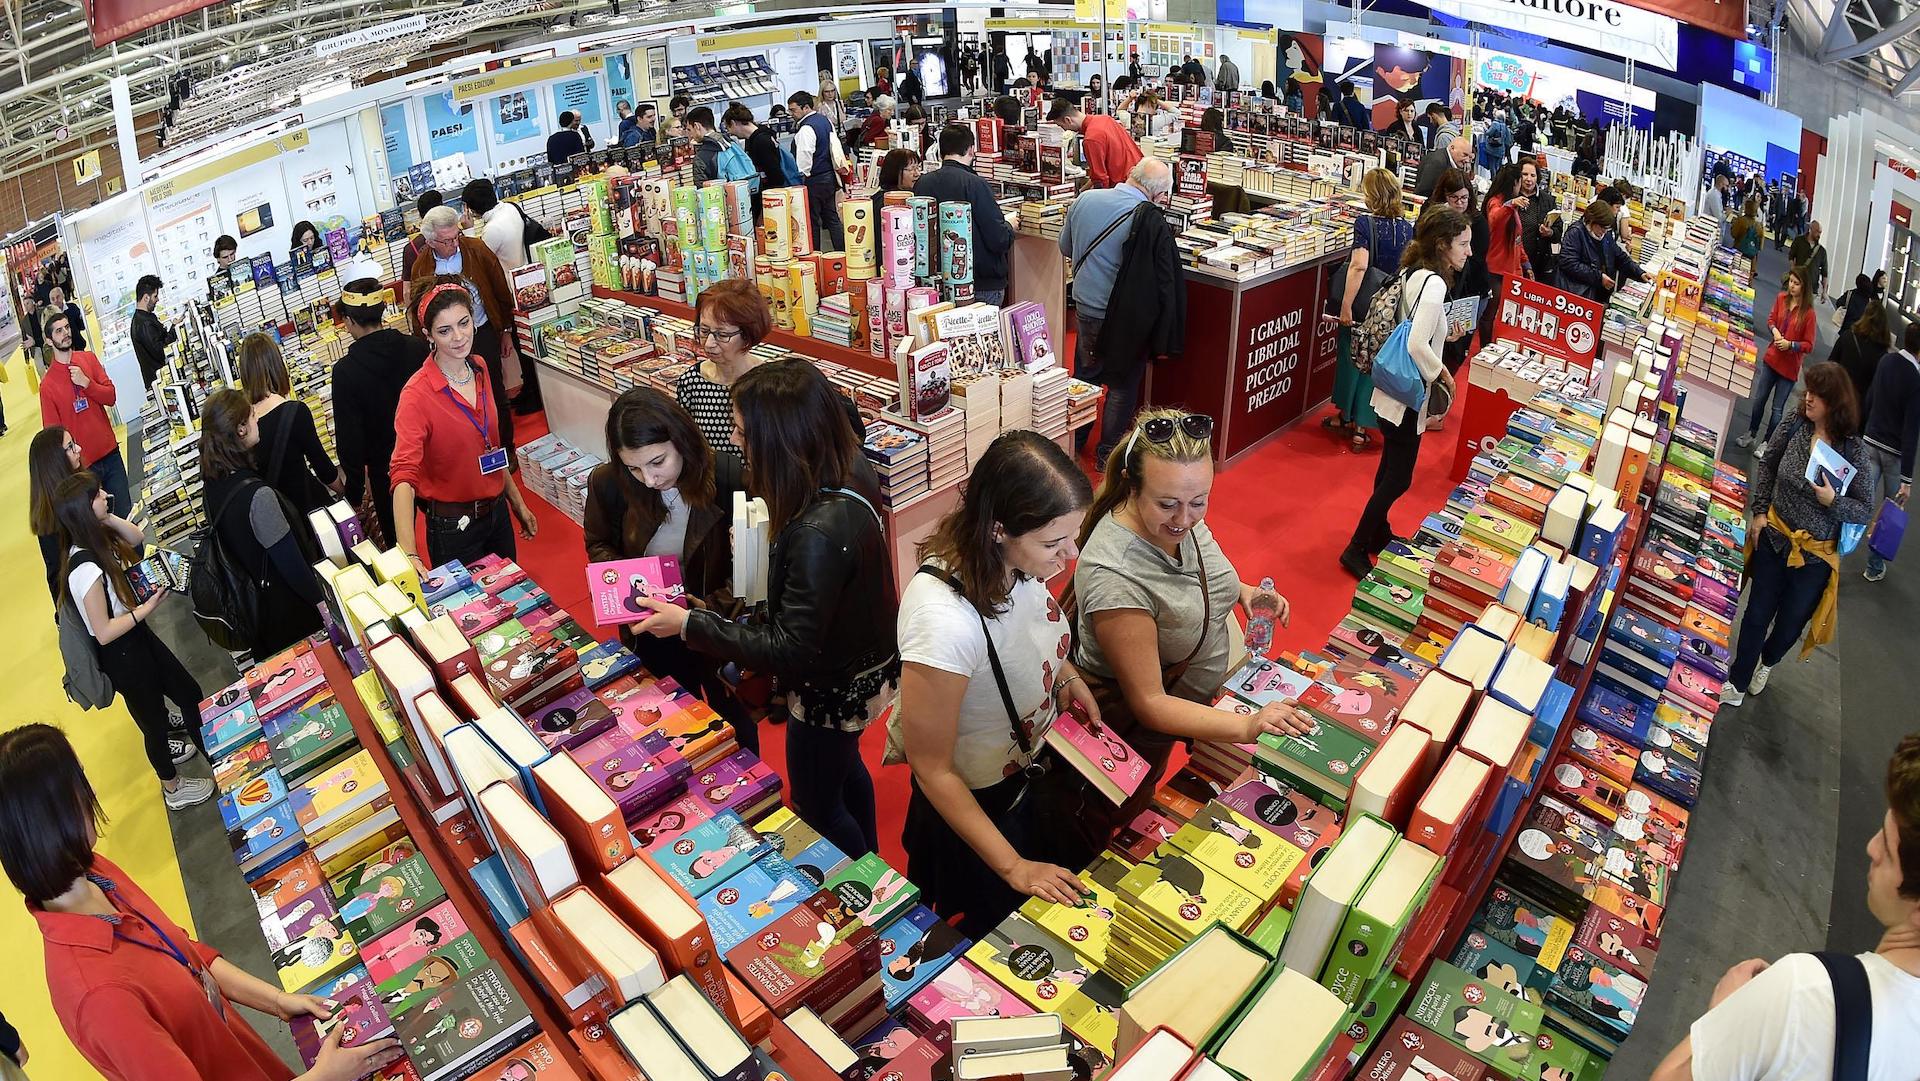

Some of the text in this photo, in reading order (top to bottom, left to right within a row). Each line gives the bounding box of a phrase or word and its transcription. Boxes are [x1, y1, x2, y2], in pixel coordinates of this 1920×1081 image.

[321, 19, 422, 52] GRUPPO MONDADORI
[701, 38, 716, 47] VIELLA
[458, 77, 496, 94] PAESI EDIZIONI
[431, 123, 463, 139] PAESI
[77, 161, 85, 178] V
[1511, 279, 1522, 296] 3
[1523, 292, 1545, 304] LIBRI
[1546, 299, 1552, 307] A
[1555, 294, 1584, 317] 9,90
[1250, 327, 1256, 346] I
[1257, 308, 1303, 341] GRANDI
[1247, 332, 1300, 370] LIBRI DAL
[1245, 353, 1298, 393] PICCOLO
[1247, 376, 1292, 414] PREZZO
[407, 866, 423, 887] avventure
[410, 858, 425, 876] TWAIN
[1261, 867, 1284, 893] DOYLE
[398, 864, 422, 899] Huckleberry Finn
[453, 941, 463, 951] La
[460, 937, 477, 959] SVEVO
[1014, 947, 1031, 967] DOYLE
[748, 955, 791, 992] Don Chisciotte
[759, 954, 797, 988] della Mancha
[1018, 949, 1037, 972] CONAN
[470, 975, 481, 987] Dr.
[474, 983, 490, 1001] Jekyll
[477, 972, 508, 1015] Lo strano caso del
[484, 966, 513, 1008] STEVENSON
[740, 962, 787, 999] CERVANTES
[358, 987, 371, 1003] viaggi
[367, 1004, 384, 1025] Gulliver
[486, 1001, 498, 1014] Mr.
[1412, 979, 1442, 1020] NIETZSCHE
[1422, 993, 1444, 1024] Così parlò
[1428, 992, 1454, 1028] Zarathustra
[491, 1010, 505, 1026] Hyde
[527, 1046, 548, 1073] Una vita
[534, 1040, 555, 1067] SVEVO
[1369, 1050, 1393, 1081] OMERO
[403, 1059, 416, 1076] L'arte
